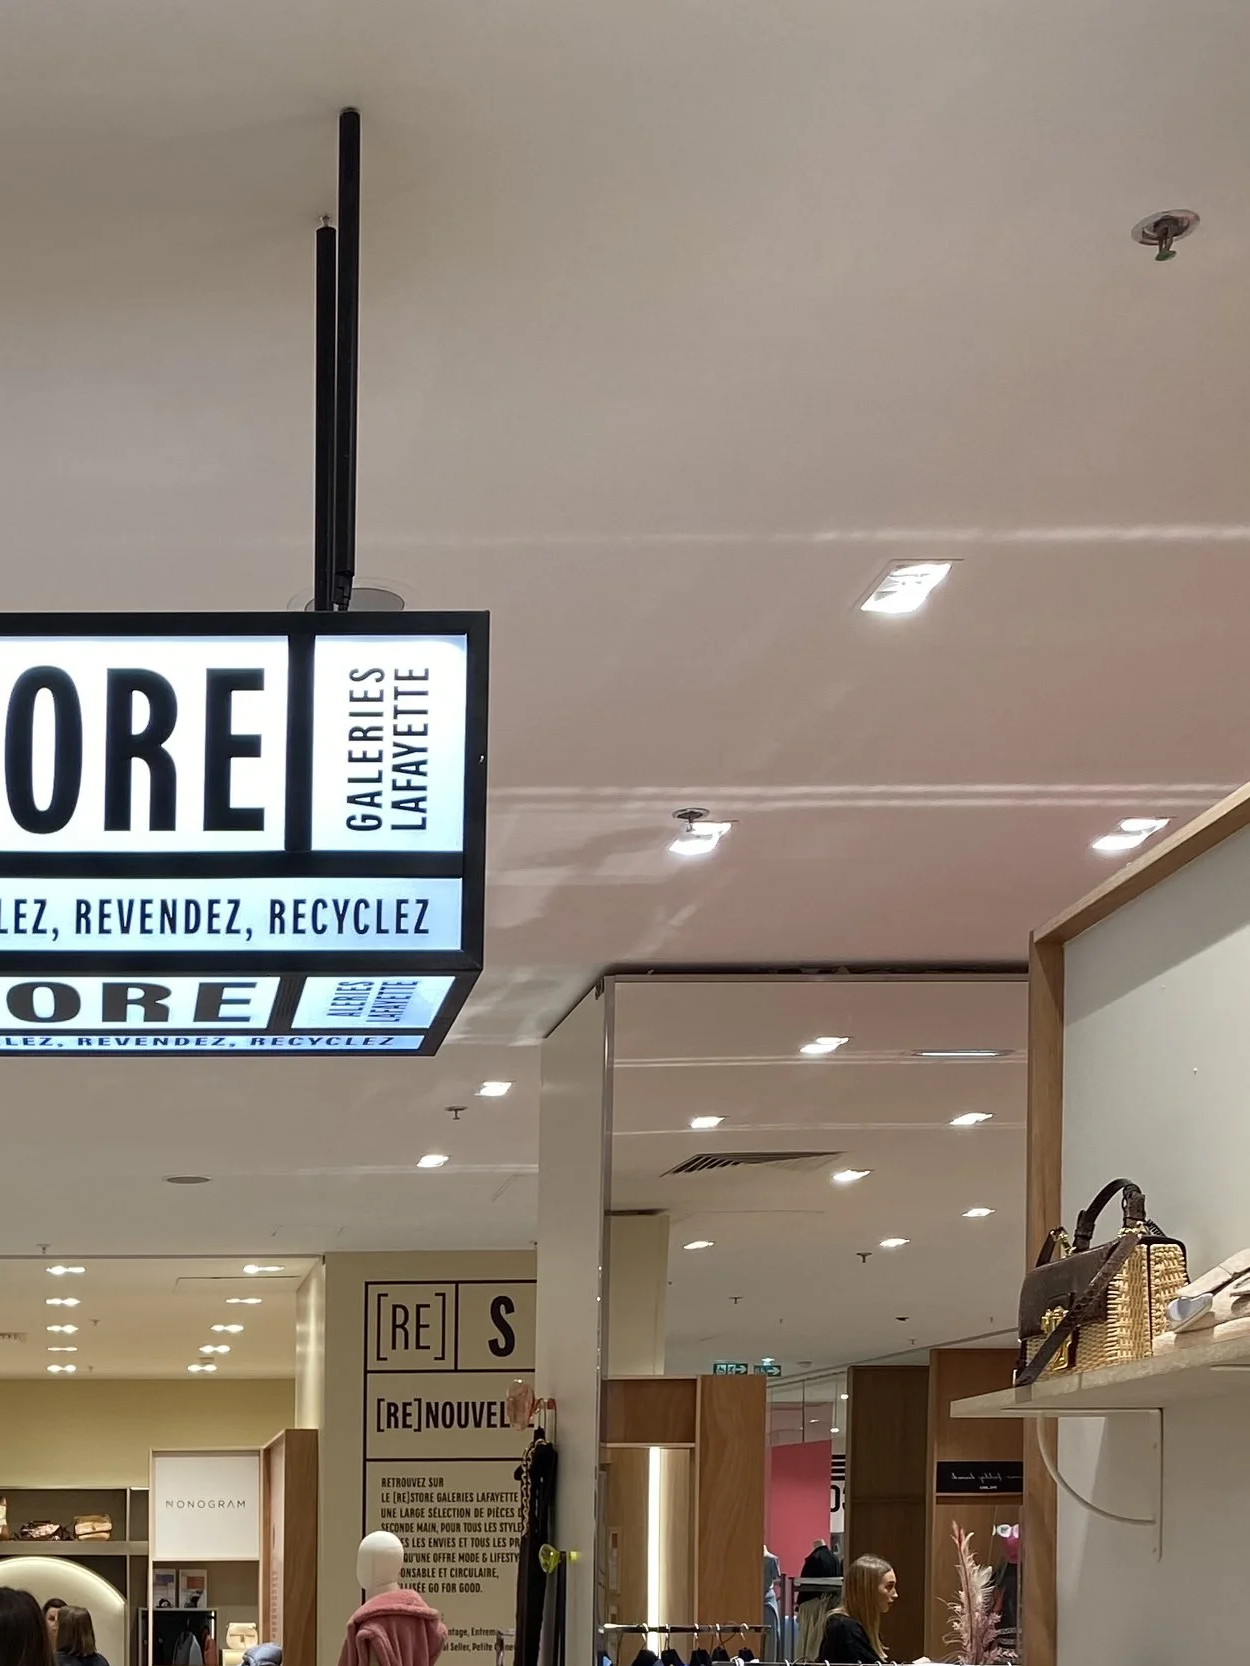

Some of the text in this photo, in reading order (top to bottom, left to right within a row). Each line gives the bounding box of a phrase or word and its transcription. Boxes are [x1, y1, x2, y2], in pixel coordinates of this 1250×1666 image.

[347, 666, 386, 833] GALERIES
[391, 666, 430, 832] LAFAYETTE
[75, 898, 254, 942] REVENDEZ,
[269, 898, 431, 935] RECYCLEZ
[366, 981, 419, 1023] LAFAYETTE
[77, 1036, 237, 1048] REVENDEZ,
[250, 1036, 395, 1047] RECYCLEZ
[377, 1292, 446, 1361] [RE]
[381, 1477, 444, 1488] RETROUVEZ SUR
[381, 1492, 390, 1503] LE
[437, 1492, 474, 1503] GALERIES
[476, 1492, 519, 1503] LAFAYETTE
[381, 1508, 397, 1518] UNE
[400, 1508, 425, 1518] LARGE
[428, 1506, 471, 1518] SÉLECTION
[474, 1508, 484, 1518] DE
[487, 1506, 515, 1518] PIÈCES
[381, 1523, 414, 1533] SECONDE
[417, 1523, 439, 1534] MAIN,
[441, 1523, 461, 1533] POUR
[463, 1523, 482, 1533] TOUS
[484, 1523, 497, 1533] LES
[412, 1538, 426, 1548] LES
[428, 1538, 456, 1548] ENVIES
[458, 1538, 467, 1548] ET
[470, 1538, 490, 1548] TOUS
[493, 1538, 506, 1548] LES
[433, 1553, 456, 1563] OFFRE
[458, 1553, 480, 1563] MODE
[482, 1553, 488, 1562] &
[490, 1553, 520, 1563] LIFESTY
[438, 1568, 447, 1578] ET
[450, 1568, 499, 1579] CIRCULAIRE,
[428, 1583, 439, 1593] GO
[441, 1583, 456, 1593] FOR
[459, 1583, 483, 1593] GOOD.
[472, 1642, 493, 1651] Petite
